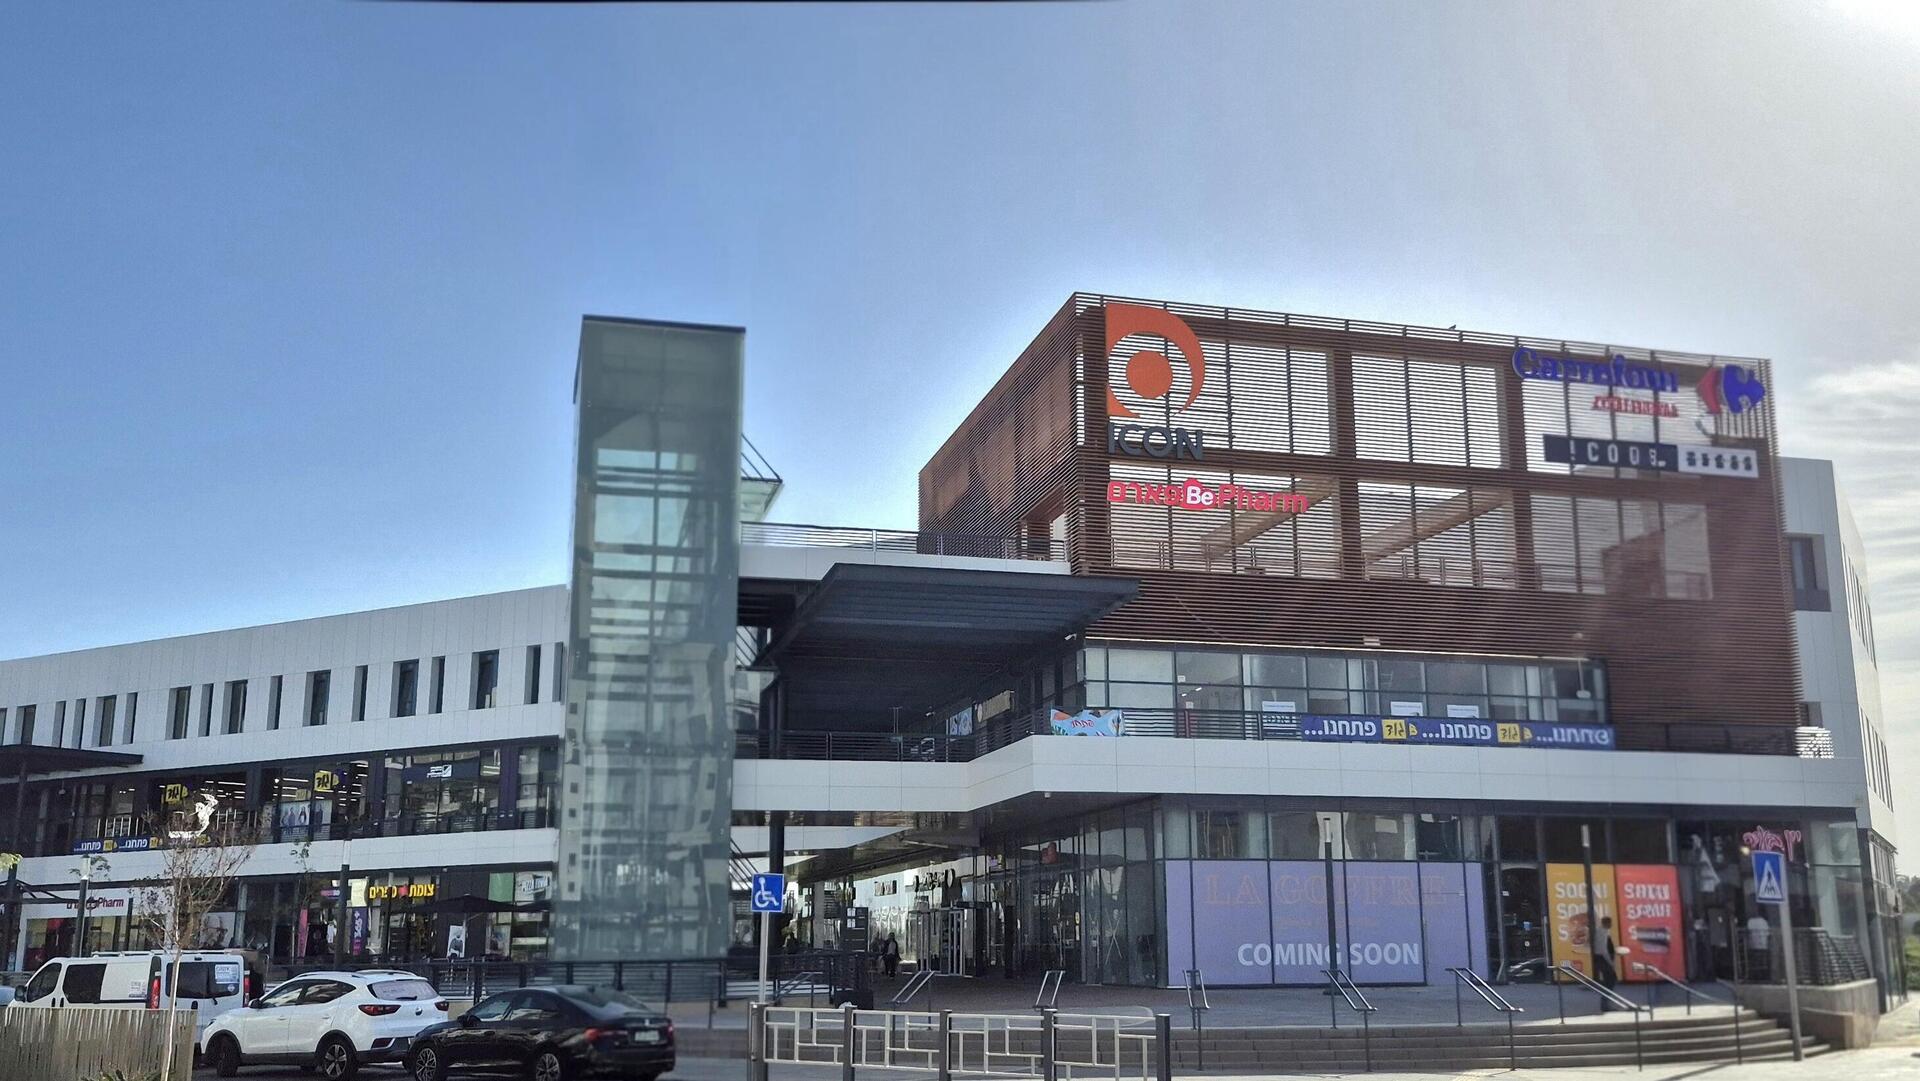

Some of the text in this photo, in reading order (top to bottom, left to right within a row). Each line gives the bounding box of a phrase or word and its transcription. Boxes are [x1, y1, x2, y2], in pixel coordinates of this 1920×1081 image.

[1108, 422, 1203, 461] ICON
[1107, 481, 1181, 505] פארם
[1187, 484, 1309, 513] Be Pharm
[408, 884, 435, 897] צומת
[97, 897, 124, 908] Pharm
[1237, 943, 1420, 966] COMING SOON
